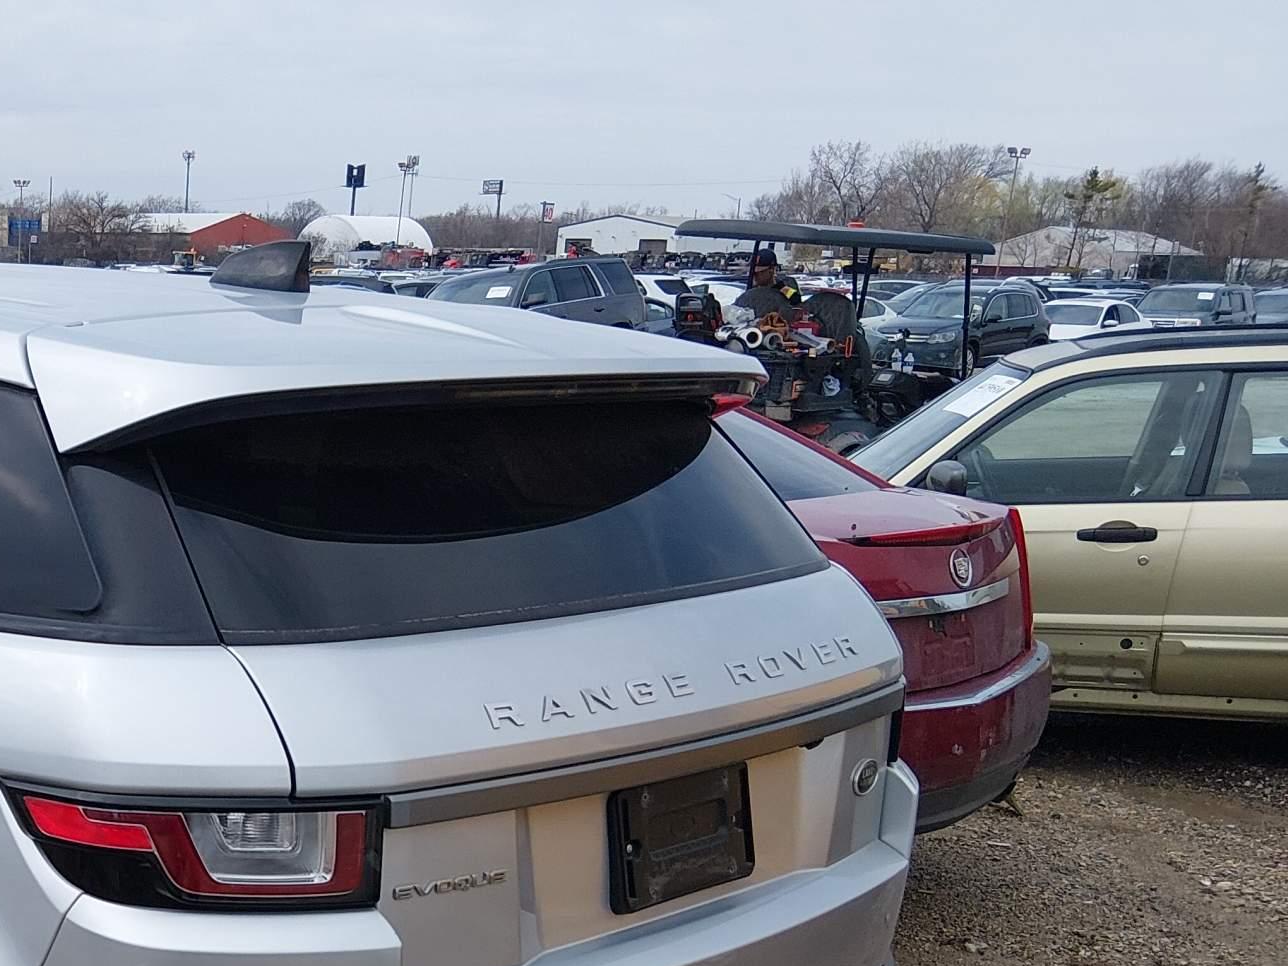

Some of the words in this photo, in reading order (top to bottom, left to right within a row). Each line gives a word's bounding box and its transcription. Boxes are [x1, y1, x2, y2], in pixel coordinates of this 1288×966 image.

[483, 673, 696, 730] RANGE
[723, 635, 859, 686] ROVER
[392, 868, 509, 900] EVOQUE
